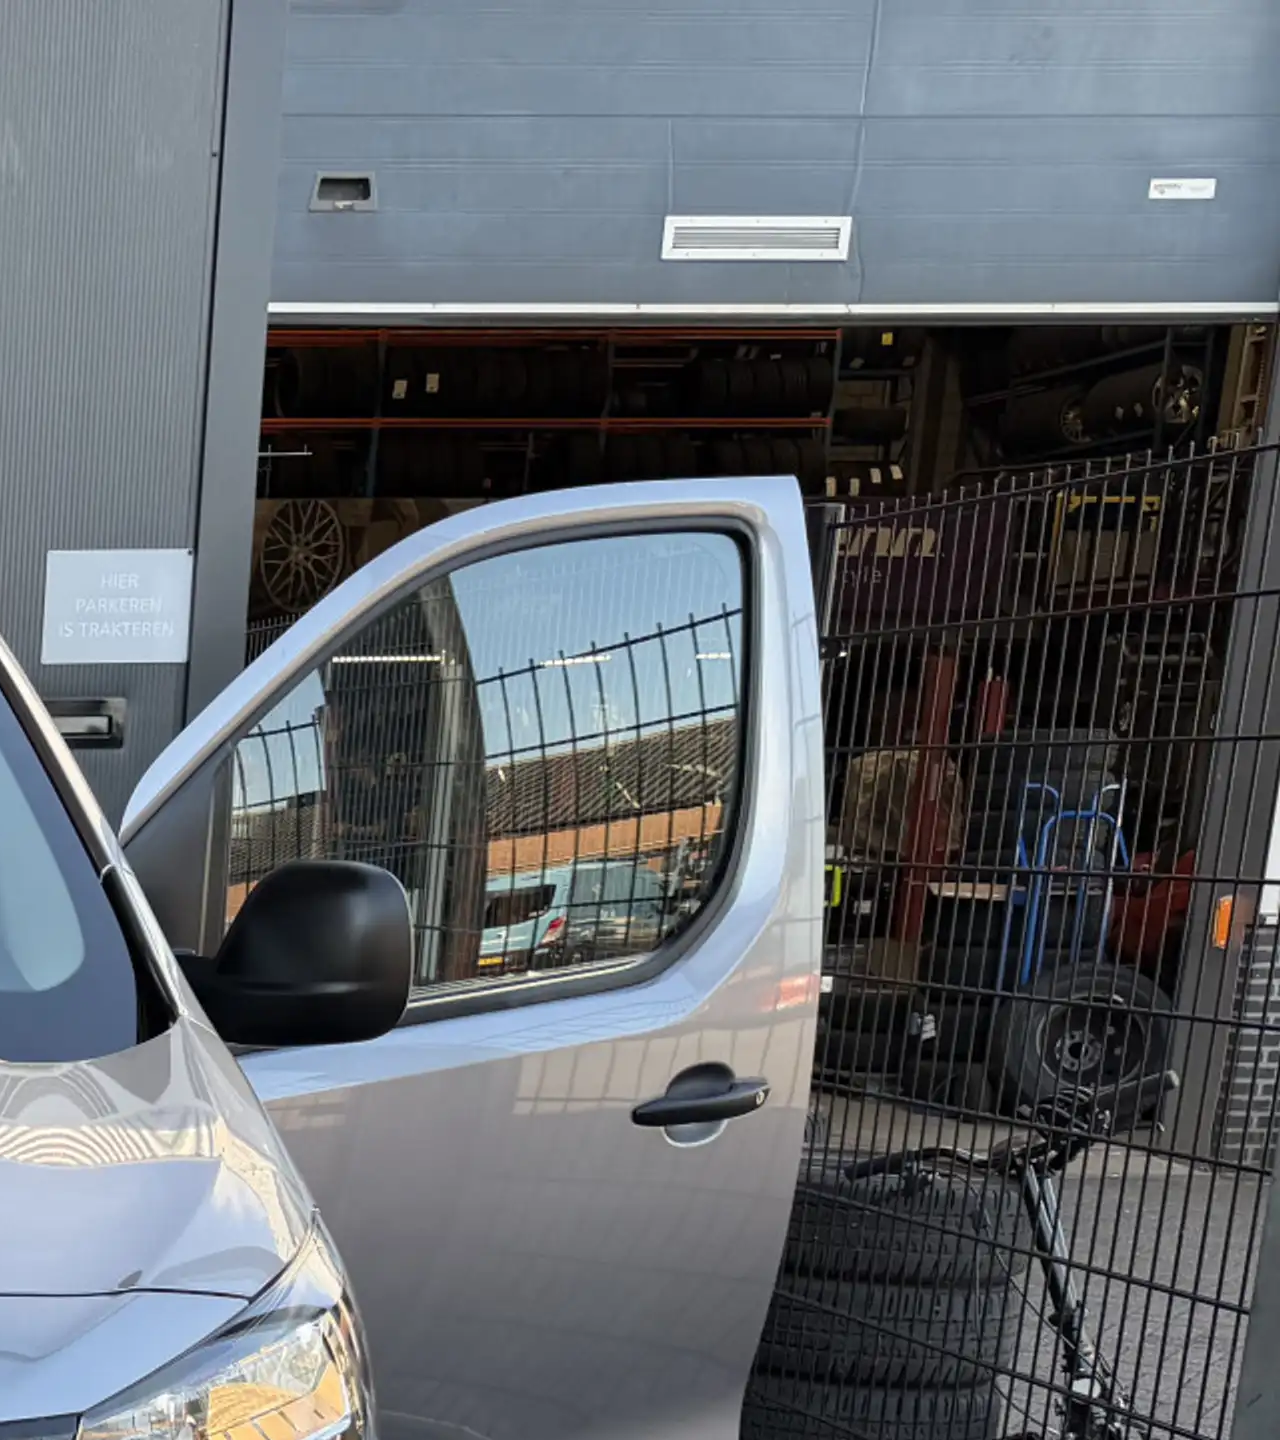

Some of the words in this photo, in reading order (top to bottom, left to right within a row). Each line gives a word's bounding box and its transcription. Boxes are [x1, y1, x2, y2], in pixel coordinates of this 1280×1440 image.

[100, 572, 140, 589] HIER
[75, 595, 163, 614] PARKEREN
[58, 620, 75, 638] IS
[78, 619, 174, 638] TRAKTEREN
